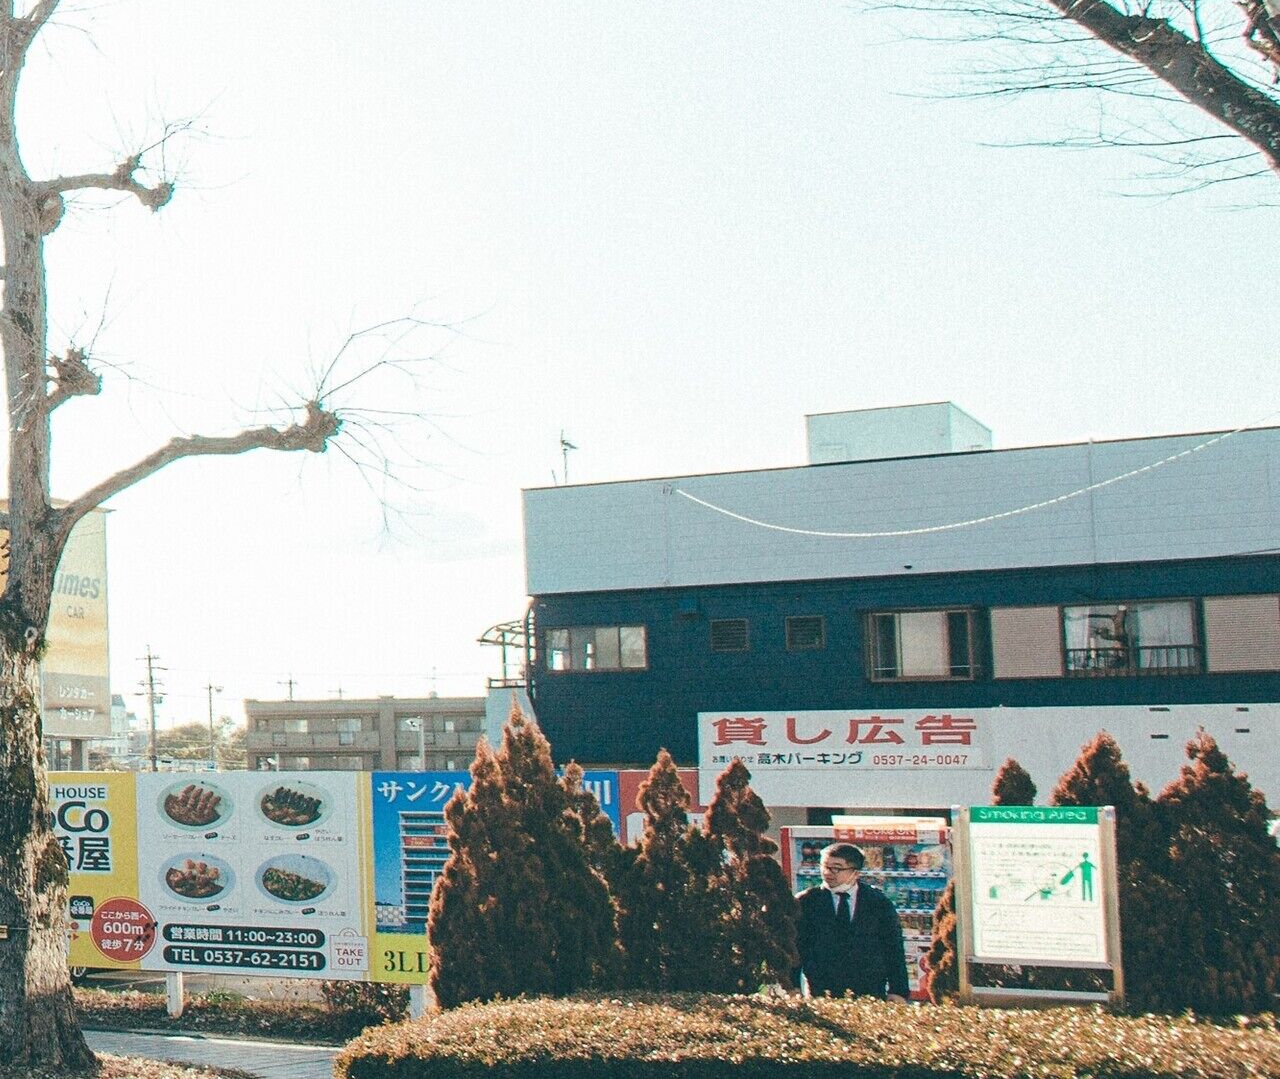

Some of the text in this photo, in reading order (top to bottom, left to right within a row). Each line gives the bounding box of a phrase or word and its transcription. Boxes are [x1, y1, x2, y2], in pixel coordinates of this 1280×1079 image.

[56, 572, 100, 600] imes
[66, 605, 85, 619] CAR
[59, 685, 95, 700] レンタカー
[712, 714, 977, 746] 貸し広告
[872, 754, 968, 766] 0537-24-0047
[55, 787, 106, 799] HOUSE
[377, 780, 466, 804] サンク
[980, 810, 1088, 820] Smoking Area
[100, 911, 149, 920] ここから西へ
[102, 921, 144, 935] 600m
[170, 926, 223, 942] 営業時間
[171, 948, 318, 968] TEL 0537-62-2151
[335, 947, 364, 957] TAKE
[337, 957, 362, 966] OUT
